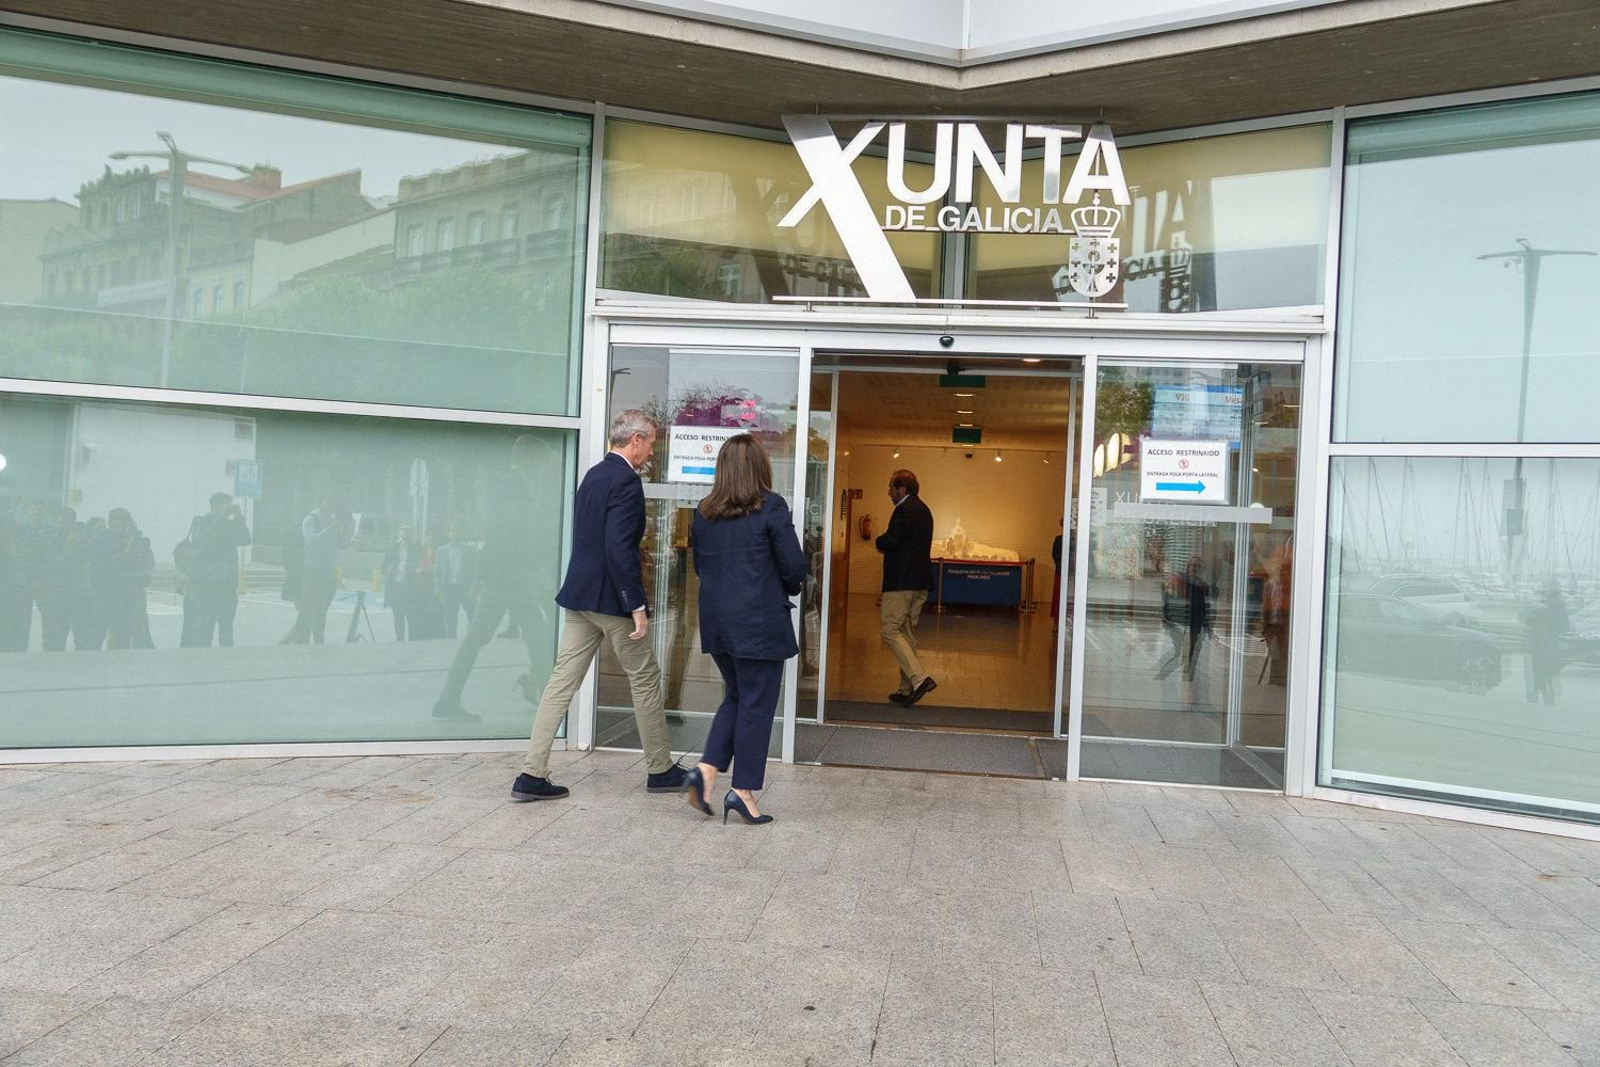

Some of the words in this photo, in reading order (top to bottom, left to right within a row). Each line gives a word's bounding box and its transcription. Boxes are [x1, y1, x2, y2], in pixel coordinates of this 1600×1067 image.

[777, 114, 1132, 301] XUNTA
[885, 205, 926, 230] DE
[937, 206, 1063, 233] GALICIA
[1176, 449, 1220, 457] RESTRINXIDO
